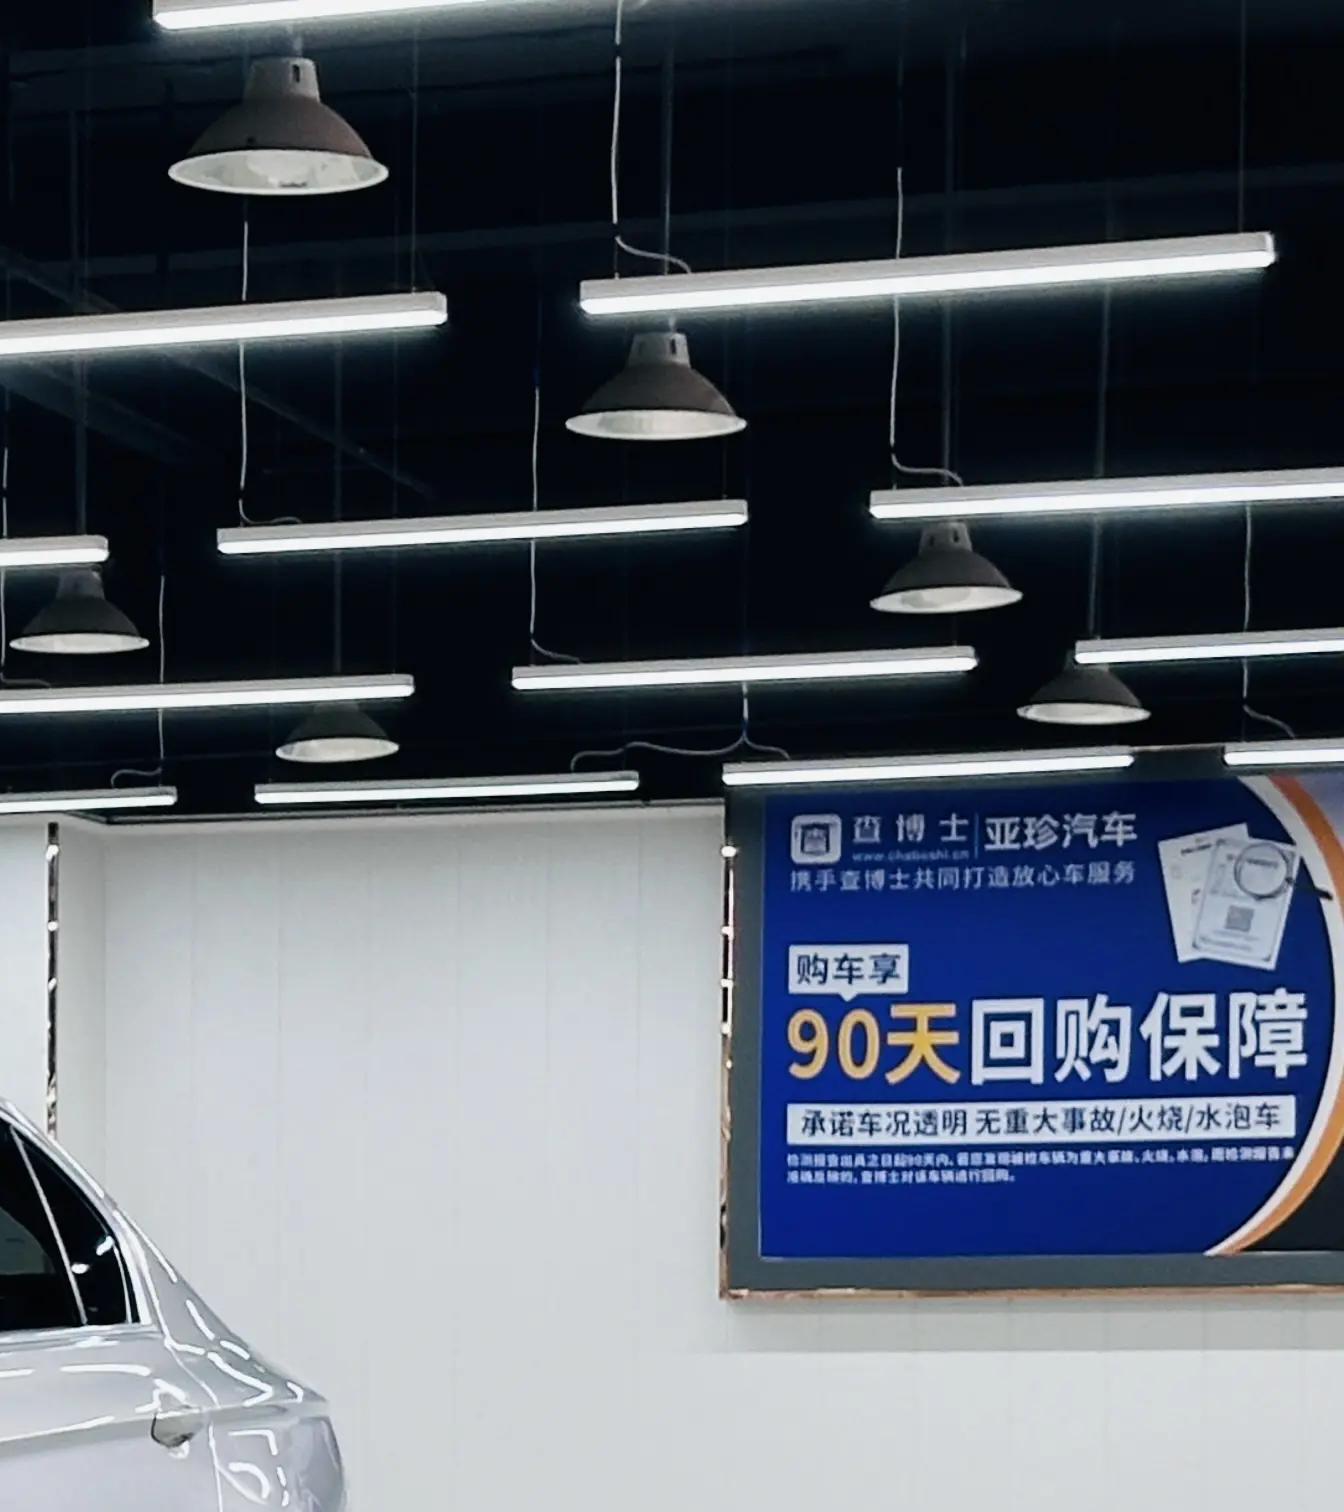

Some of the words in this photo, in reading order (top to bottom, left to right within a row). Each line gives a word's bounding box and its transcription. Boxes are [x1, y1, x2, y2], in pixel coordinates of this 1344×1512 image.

[852, 813, 969, 844] 查博士
[984, 811, 1137, 851] 亚珍汽车
[790, 860, 1136, 892] 携手查博士共同打造放心车服务
[795, 952, 902, 986] 购车享
[787, 987, 1309, 1085] 90天回购保障
[801, 1107, 968, 1138] 承诺车况透明
[975, 1101, 1280, 1135] 无重大事故/火烧/水泡车
